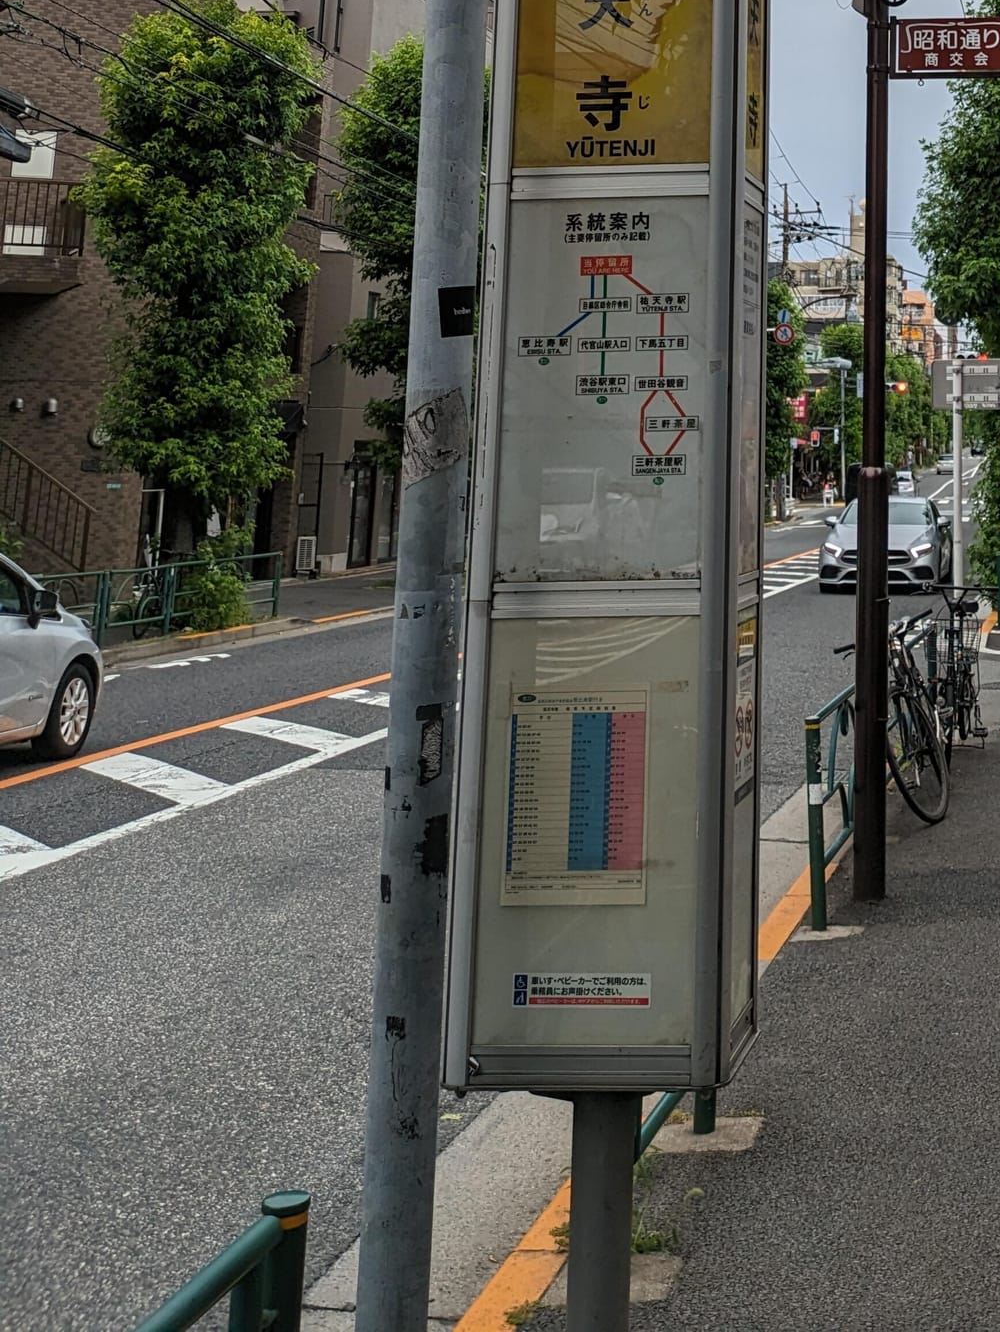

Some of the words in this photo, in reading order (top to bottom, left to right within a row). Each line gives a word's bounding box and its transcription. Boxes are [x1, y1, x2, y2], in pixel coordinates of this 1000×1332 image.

[913, 28, 1000, 50] 昭和通り
[924, 52, 989, 67] 商交会
[638, 95, 652, 110] じ
[565, 211, 650, 232] 系統案内
[583, 257, 629, 268] 当停留所
[580, 338, 628, 350] 代官山駅入口
